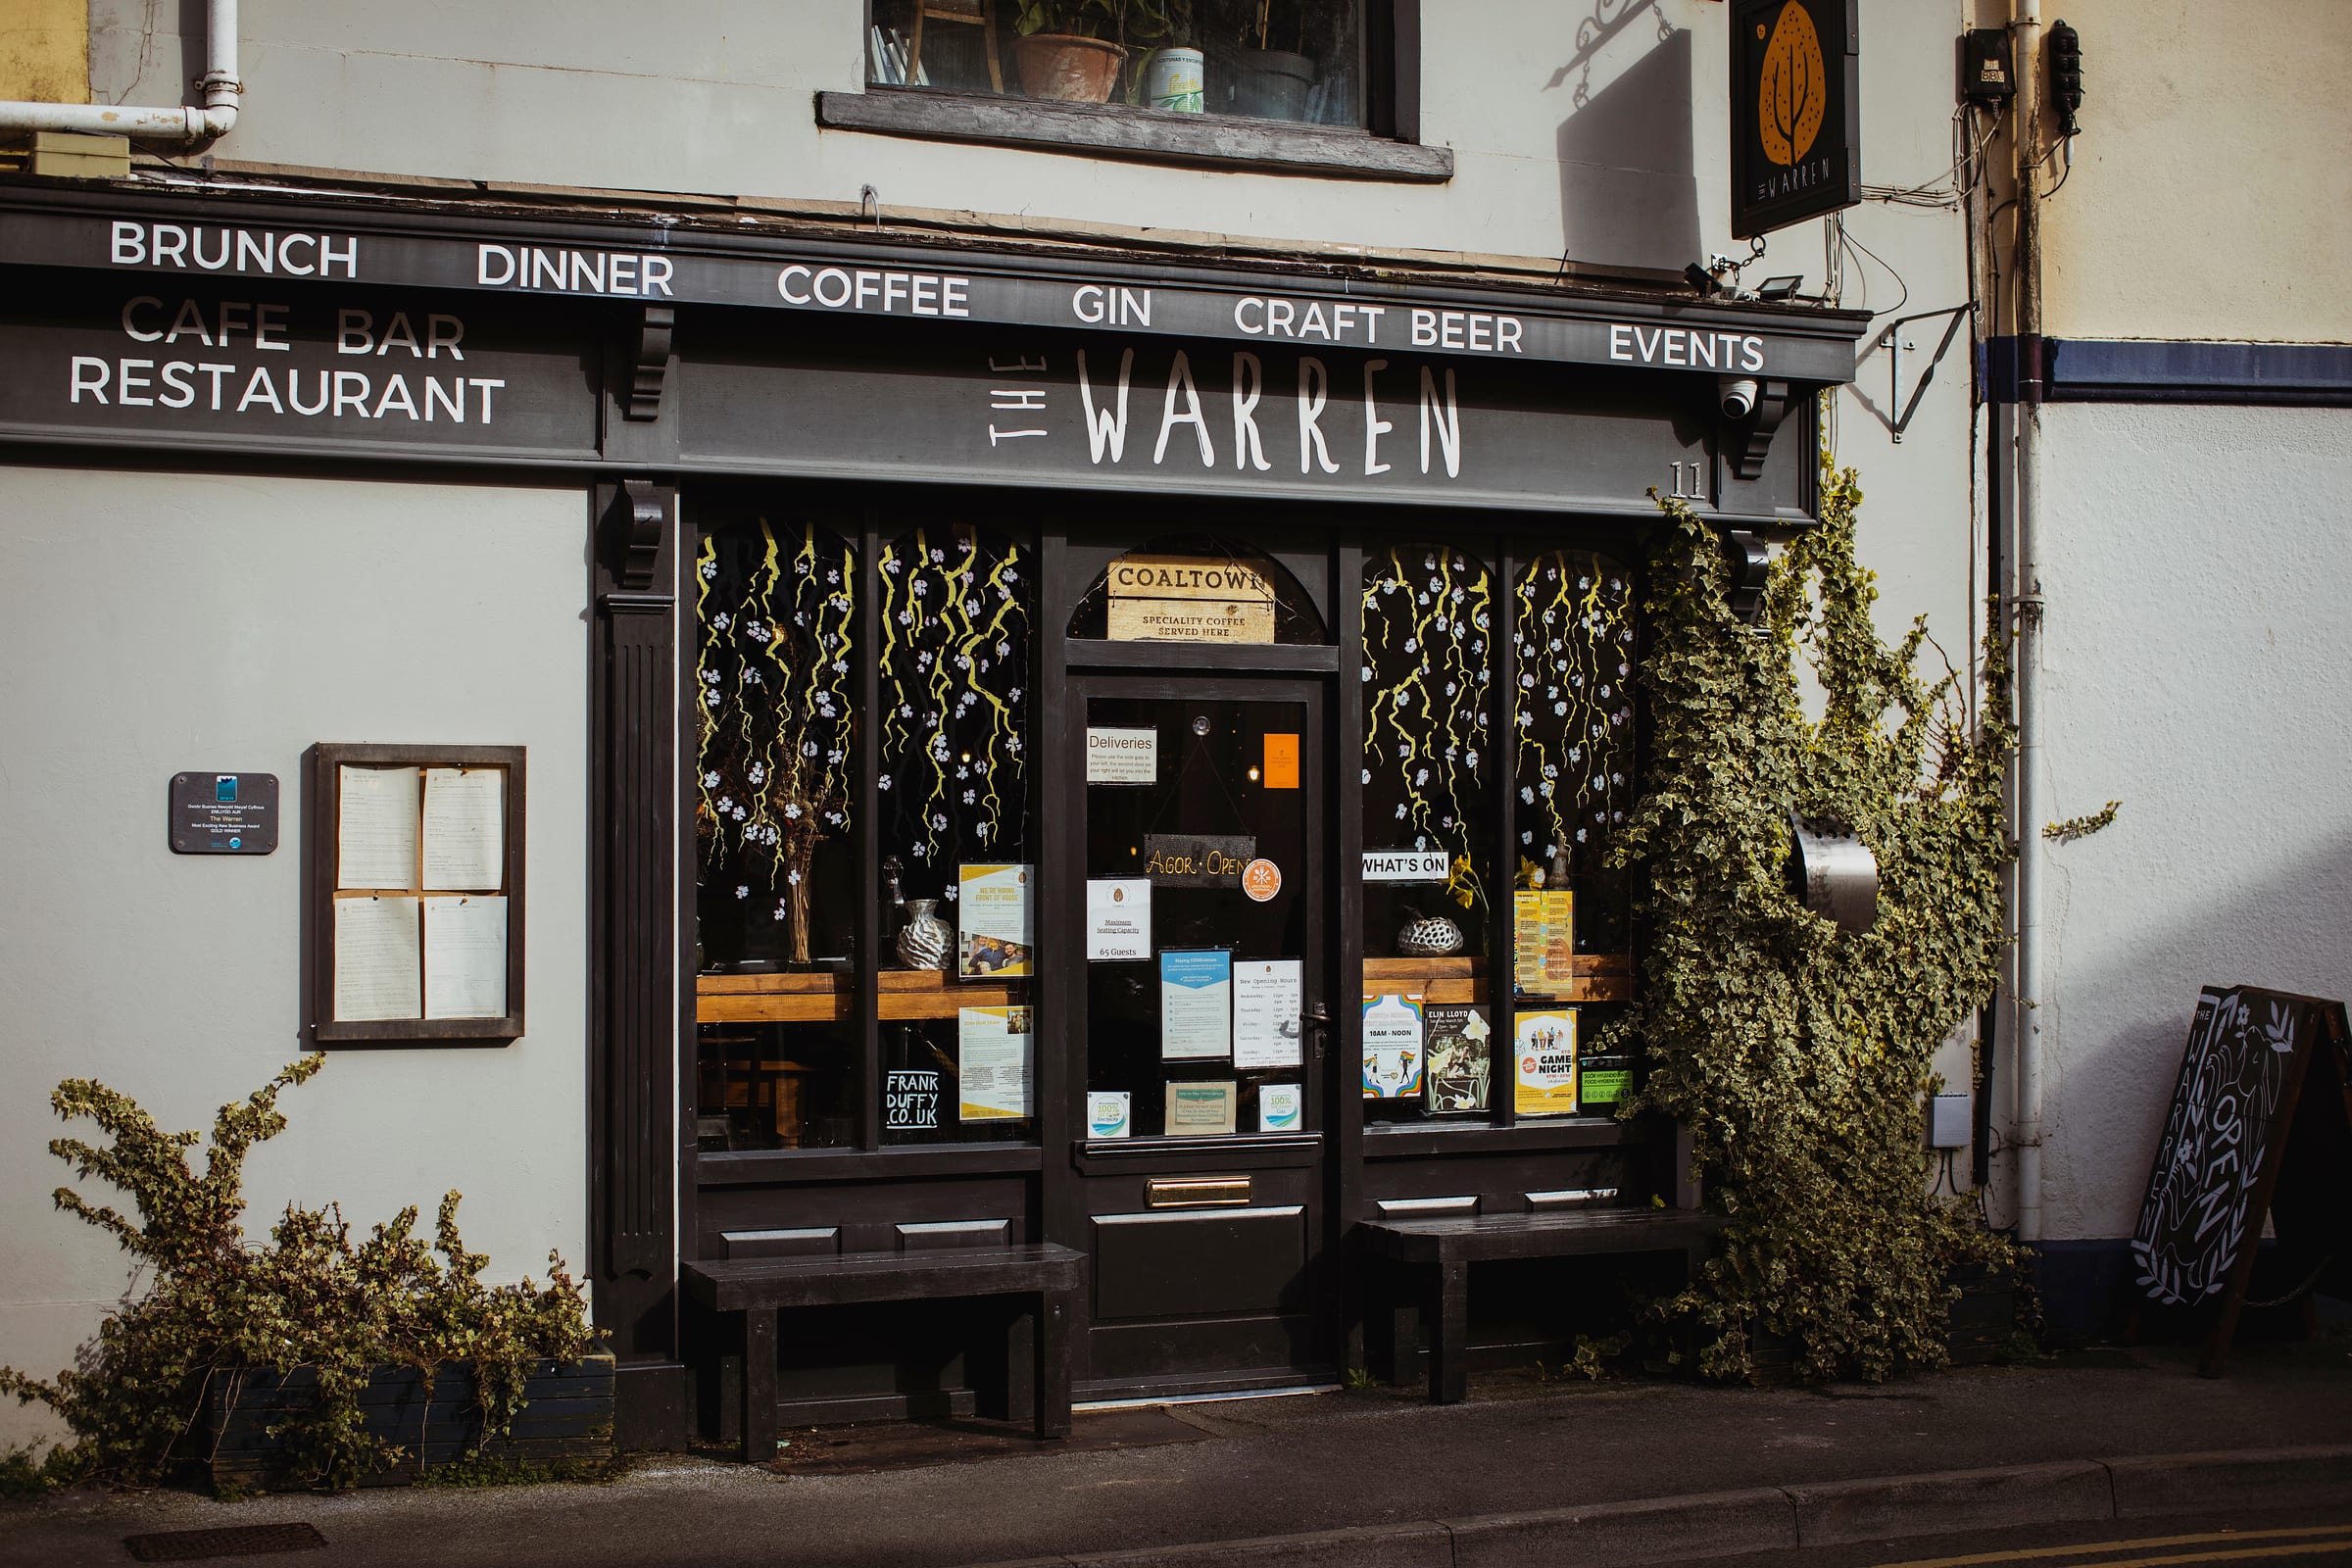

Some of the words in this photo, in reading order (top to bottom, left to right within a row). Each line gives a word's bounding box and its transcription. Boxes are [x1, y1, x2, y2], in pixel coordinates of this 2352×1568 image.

[1768, 157, 1829, 199] WARREN
[111, 220, 358, 278] BRUNCH
[477, 243, 673, 296] DINNER
[778, 265, 969, 318] COFFEE
[1072, 284, 1151, 326] GIN
[122, 295, 290, 352] CAFE
[337, 307, 465, 361] BAR
[1234, 296, 1385, 345] CRAFT
[1411, 309, 1522, 354] BEER
[1610, 324, 1764, 372] EVENTS
[70, 356, 505, 424] RESTAURANT
[988, 354, 1048, 448] THE
[1077, 346, 1460, 479] WARREN
[1669, 461, 1704, 500] 11
[1117, 567, 1266, 590] COALTOWN
[1143, 614, 1203, 626] SPECIALITY
[1205, 616, 1246, 627] COFFEE
[1158, 627, 1199, 637] SERVED
[1201, 628, 1230, 637] HERE
[1089, 735, 1152, 750] Deliveries
[1146, 849, 1197, 874] AGOR
[1362, 858, 1418, 872] WHAT'S
[1423, 858, 1445, 872] ON
[1100, 948, 1109, 956] 65
[1110, 948, 1137, 956] Guests
[2196, 1009, 2210, 1022] THE
[1538, 1064, 1572, 1074] NIGHT
[1540, 1054, 1572, 1064] GAME
[886, 1075, 938, 1092] FRANK
[1622, 1089, 1629, 1098] 5
[886, 1093, 938, 1109] DUFFY
[1097, 1104, 1120, 1113] 100%
[1270, 1096, 1292, 1105] 100%
[2138, 1029, 2206, 1238] WARREN
[2194, 1094, 2243, 1245] OPEN
